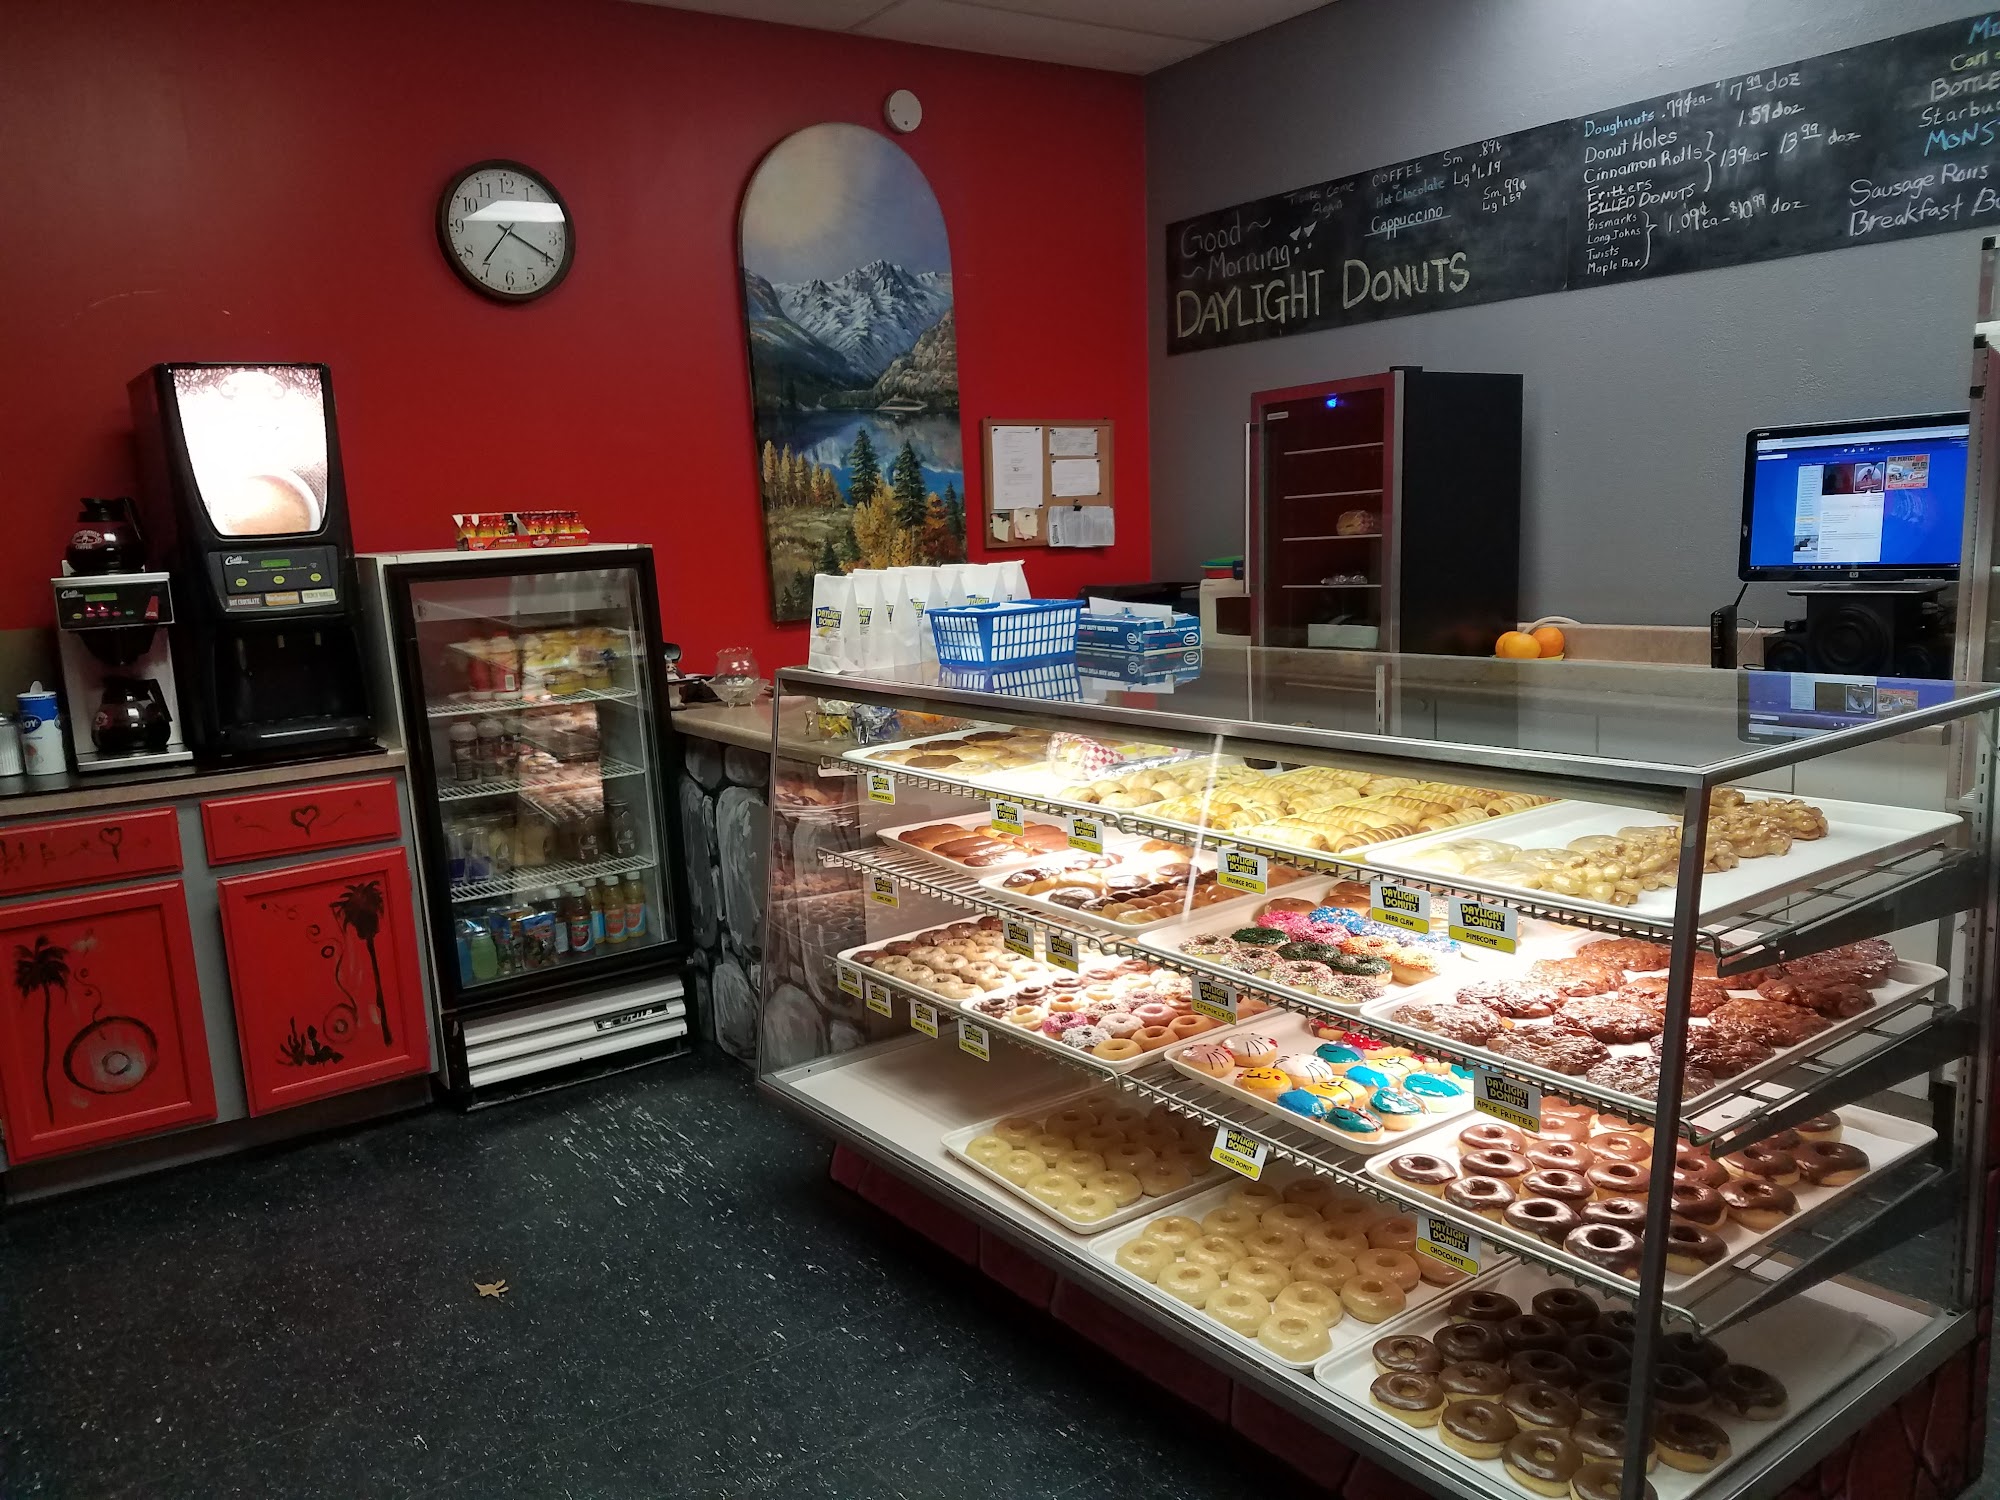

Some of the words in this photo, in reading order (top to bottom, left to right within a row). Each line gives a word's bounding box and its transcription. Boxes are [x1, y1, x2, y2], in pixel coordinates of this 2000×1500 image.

[1584, 110, 1655, 138] Doughnuts
[1584, 139, 1629, 164] Donut
[1632, 127, 1678, 152] Holes
[1924, 119, 2000, 157] MONS
[1583, 157, 1657, 184] Cinnamon
[1660, 143, 1703, 167] Rolls
[1372, 161, 1423, 188] COFFEE
[478, 182, 491, 198] 11
[499, 178, 514, 195] 12
[1395, 177, 1446, 202] Chocolate
[1587, 179, 1653, 202] Fritters
[1850, 173, 1935, 207] Sausage
[1941, 163, 1990, 184] Rolls
[463, 196, 478, 213] 10
[1587, 194, 1636, 219] FILLED
[1638, 182, 1697, 208] DONUTS
[1371, 205, 1444, 240] Cappuccino
[1587, 213, 1637, 231] Bismarks
[1850, 193, 1964, 237] Breakfast
[455, 218, 465, 234] 9
[1180, 209, 1241, 258] Good
[1587, 234, 1611, 245] Long
[1611, 226, 1641, 241] Johns
[548, 231, 558, 246] 3
[464, 244, 474, 259] 8
[1586, 244, 1620, 260] Twists
[482, 262, 491, 278] 7
[526, 267, 536, 282] 5
[1587, 259, 1618, 277] Maple
[1621, 257, 1641, 268] Bar
[505, 270, 515, 286] 6
[1175, 268, 1326, 339] DAYLIGHT
[1341, 251, 1470, 310] DONUTS
[817, 608, 842, 619] DAYLIGHT
[818, 617, 840, 627] DONUTS
[1226, 853, 1258, 868] DAYLIGHT
[1229, 862, 1256, 875] DONUTS
[1382, 886, 1420, 904] DAYLIGHT
[1385, 896, 1418, 912] DONUTS
[1461, 903, 1506, 922] DAYLIGHT
[1465, 913, 1502, 931] DONUTS
[1050, 936, 1073, 950] DAYLIGHT
[1052, 942, 1072, 956] DONUTS
[1199, 982, 1229, 999] DAYLIGHT
[1202, 990, 1227, 1006] DONUTS
[1486, 1077, 1529, 1100] DAYLIGHT
[1490, 1087, 1527, 1108] DONUTS
[1476, 1099, 1498, 1114] APPLE
[1500, 1108, 1534, 1128] FRITTER
[1227, 1129, 1259, 1151] DAYLIGHT
[1227, 1139, 1255, 1158] DONUTS
[1430, 1219, 1470, 1243] DAYLIGHT
[1433, 1229, 1467, 1250] DONUTS
[1430, 1246, 1465, 1267] CHOCOLATE
